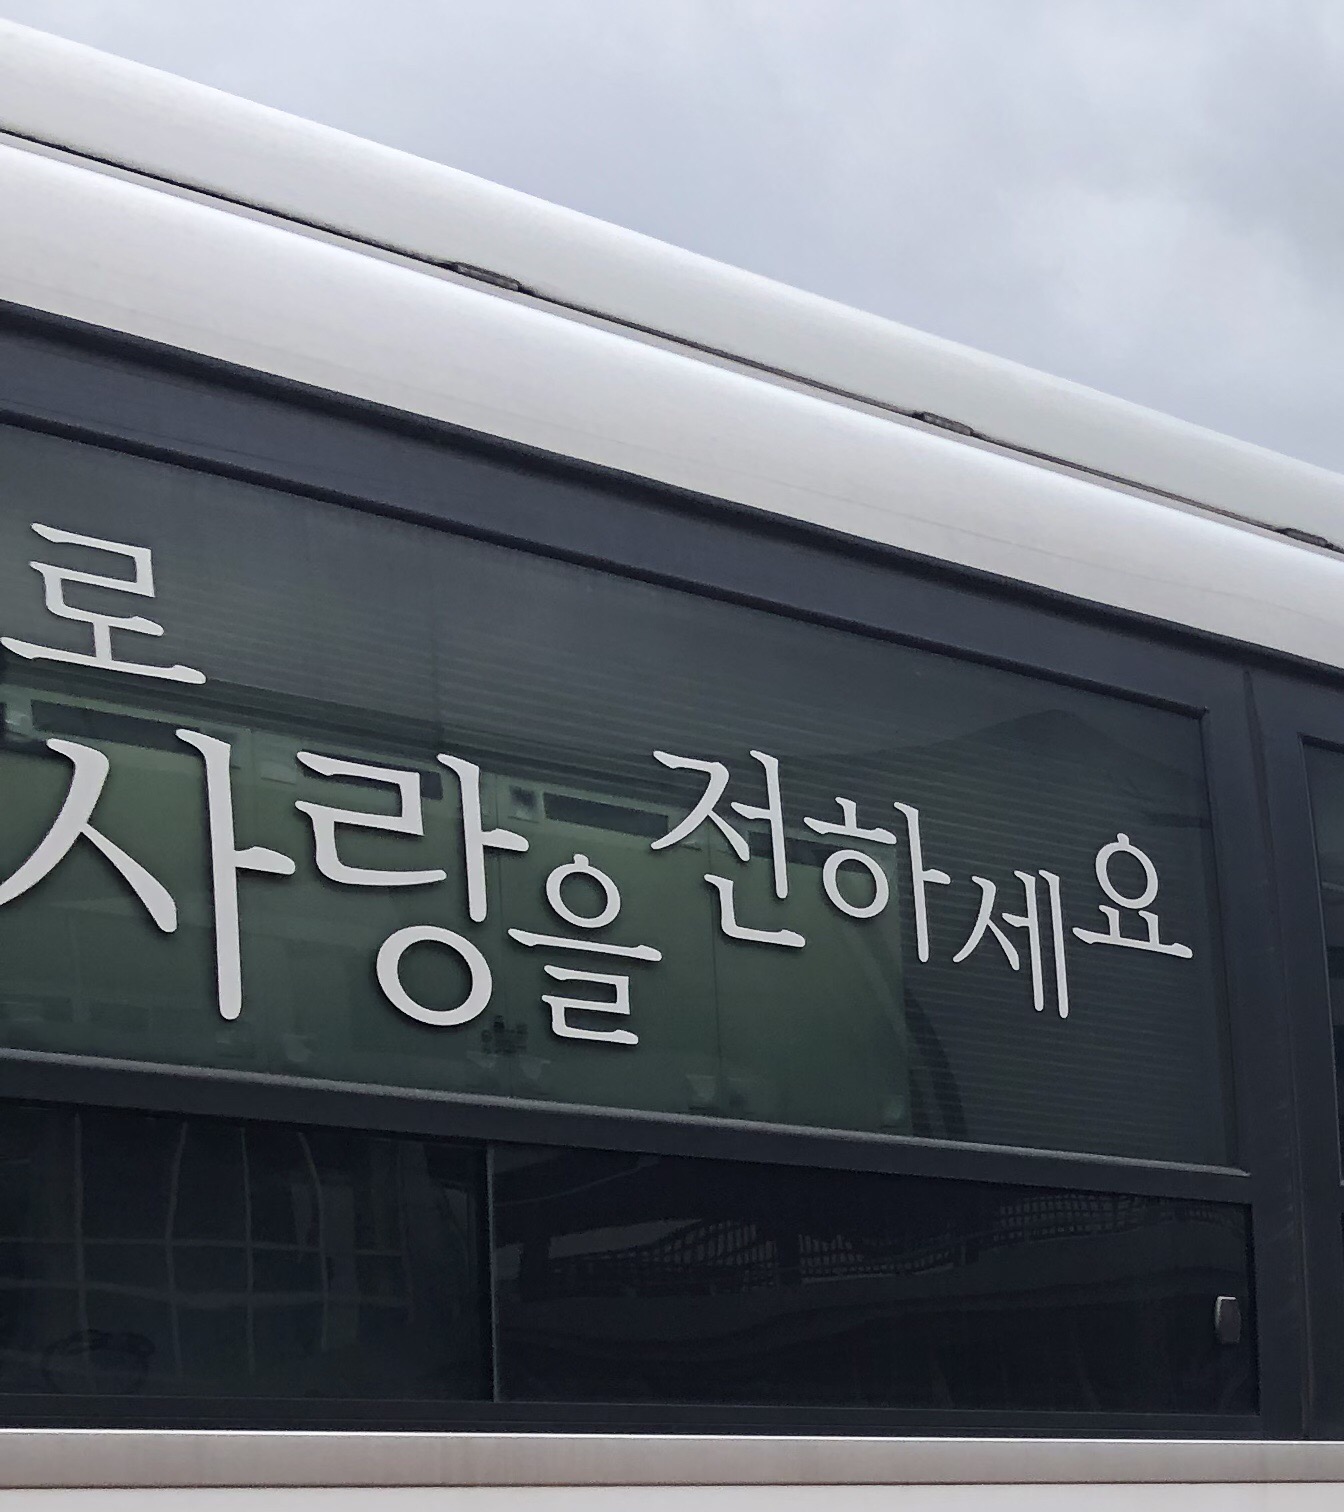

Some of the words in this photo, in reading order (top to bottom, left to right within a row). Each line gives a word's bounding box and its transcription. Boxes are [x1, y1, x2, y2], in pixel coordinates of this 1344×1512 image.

[1, 522, 206, 684] 로
[0, 728, 662, 1045] 사랑을
[650, 750, 1194, 1019] 전하세요
